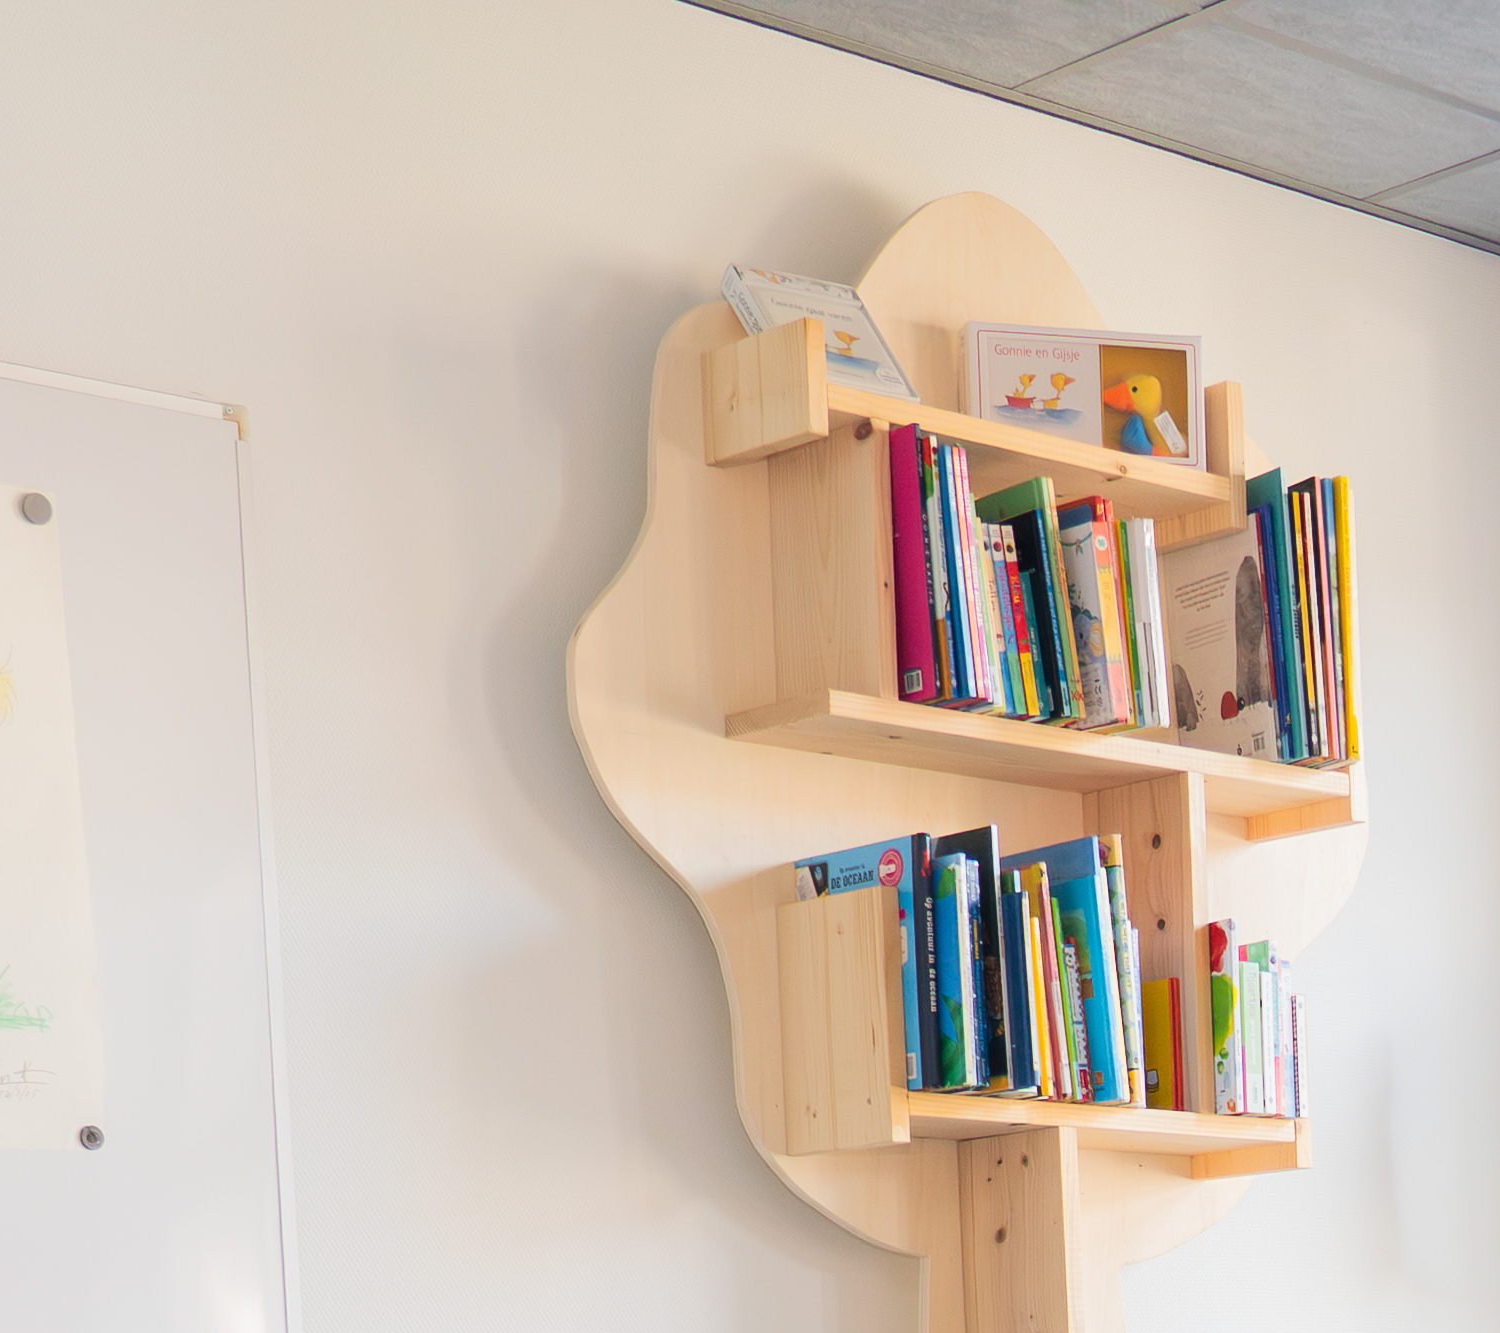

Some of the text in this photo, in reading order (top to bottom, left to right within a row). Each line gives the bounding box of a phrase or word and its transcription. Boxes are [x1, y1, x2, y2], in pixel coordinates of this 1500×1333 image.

[994, 343, 1081, 363] Gonnie en Gijsje
[830, 869, 875, 890] DE OCEAAN
[925, 897, 937, 1013] Op avontuur in de oceaan
